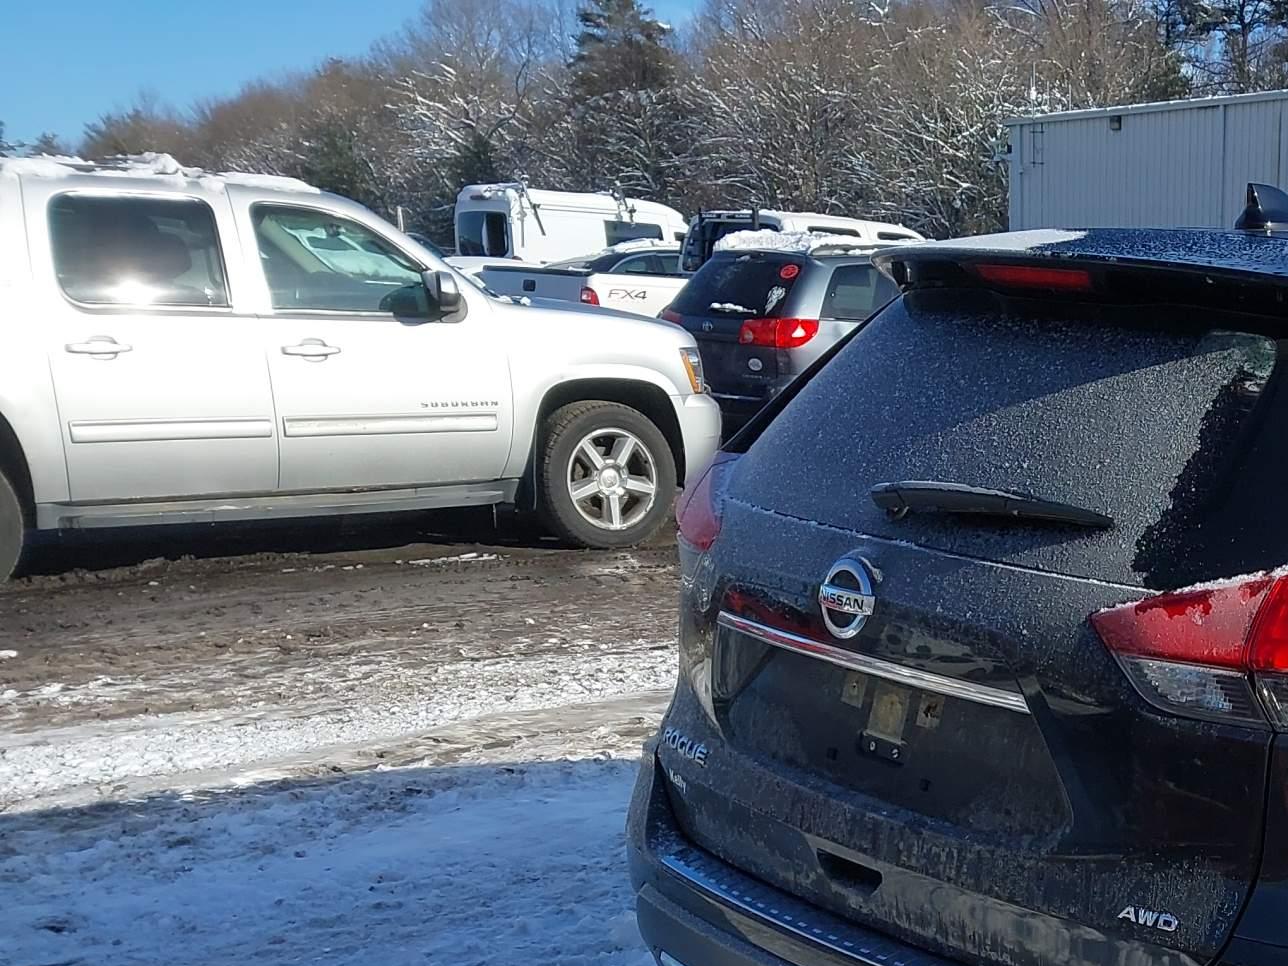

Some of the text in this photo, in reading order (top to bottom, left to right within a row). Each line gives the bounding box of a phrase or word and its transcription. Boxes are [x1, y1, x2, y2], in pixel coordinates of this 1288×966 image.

[607, 288, 648, 301] FX4
[420, 400, 499, 409] SUBURBAN
[821, 591, 864, 611] NISSAN
[662, 727, 708, 766] ROGUE
[1116, 904, 1179, 932] AWD
